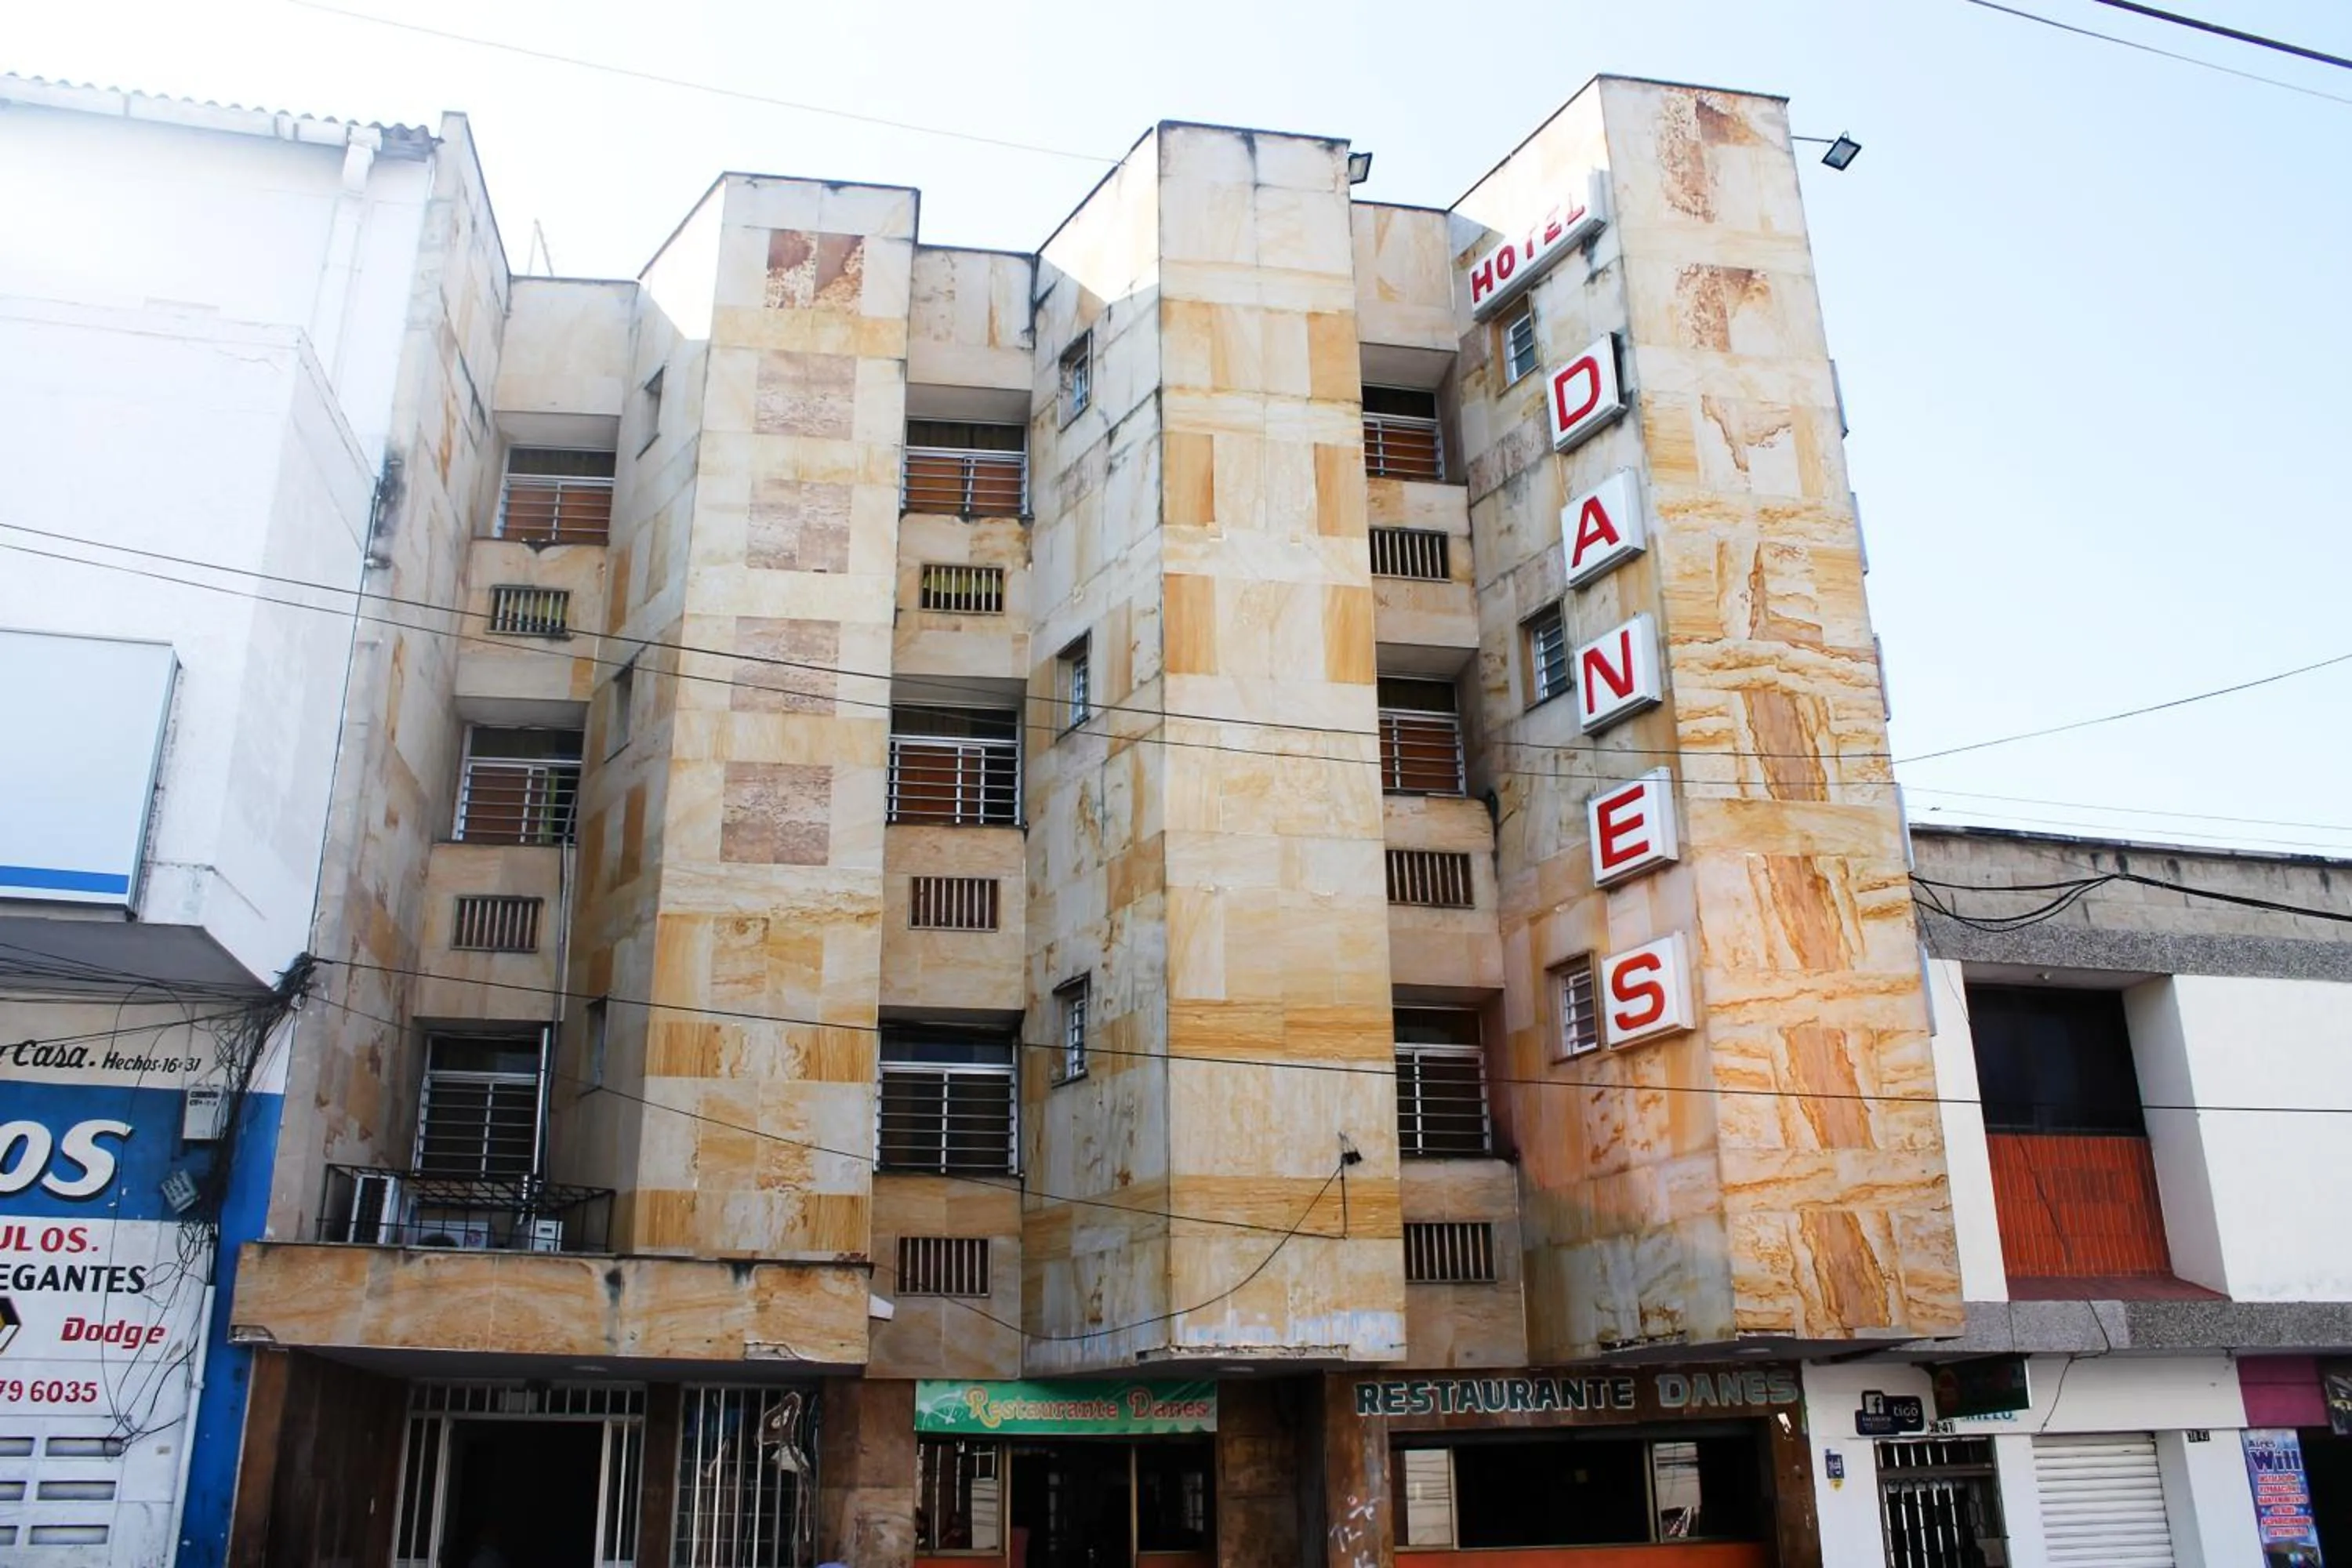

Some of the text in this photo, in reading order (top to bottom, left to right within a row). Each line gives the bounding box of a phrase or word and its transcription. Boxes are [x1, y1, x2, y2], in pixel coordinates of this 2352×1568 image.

[61, 1316, 165, 1349] Dodge
[30, 1380, 98, 1403] 6035
[965, 1386, 1119, 1428] Restaurante
[1355, 1370, 1798, 1416] RESTAURANTE DANES
[2249, 1449, 2303, 1472] Will
